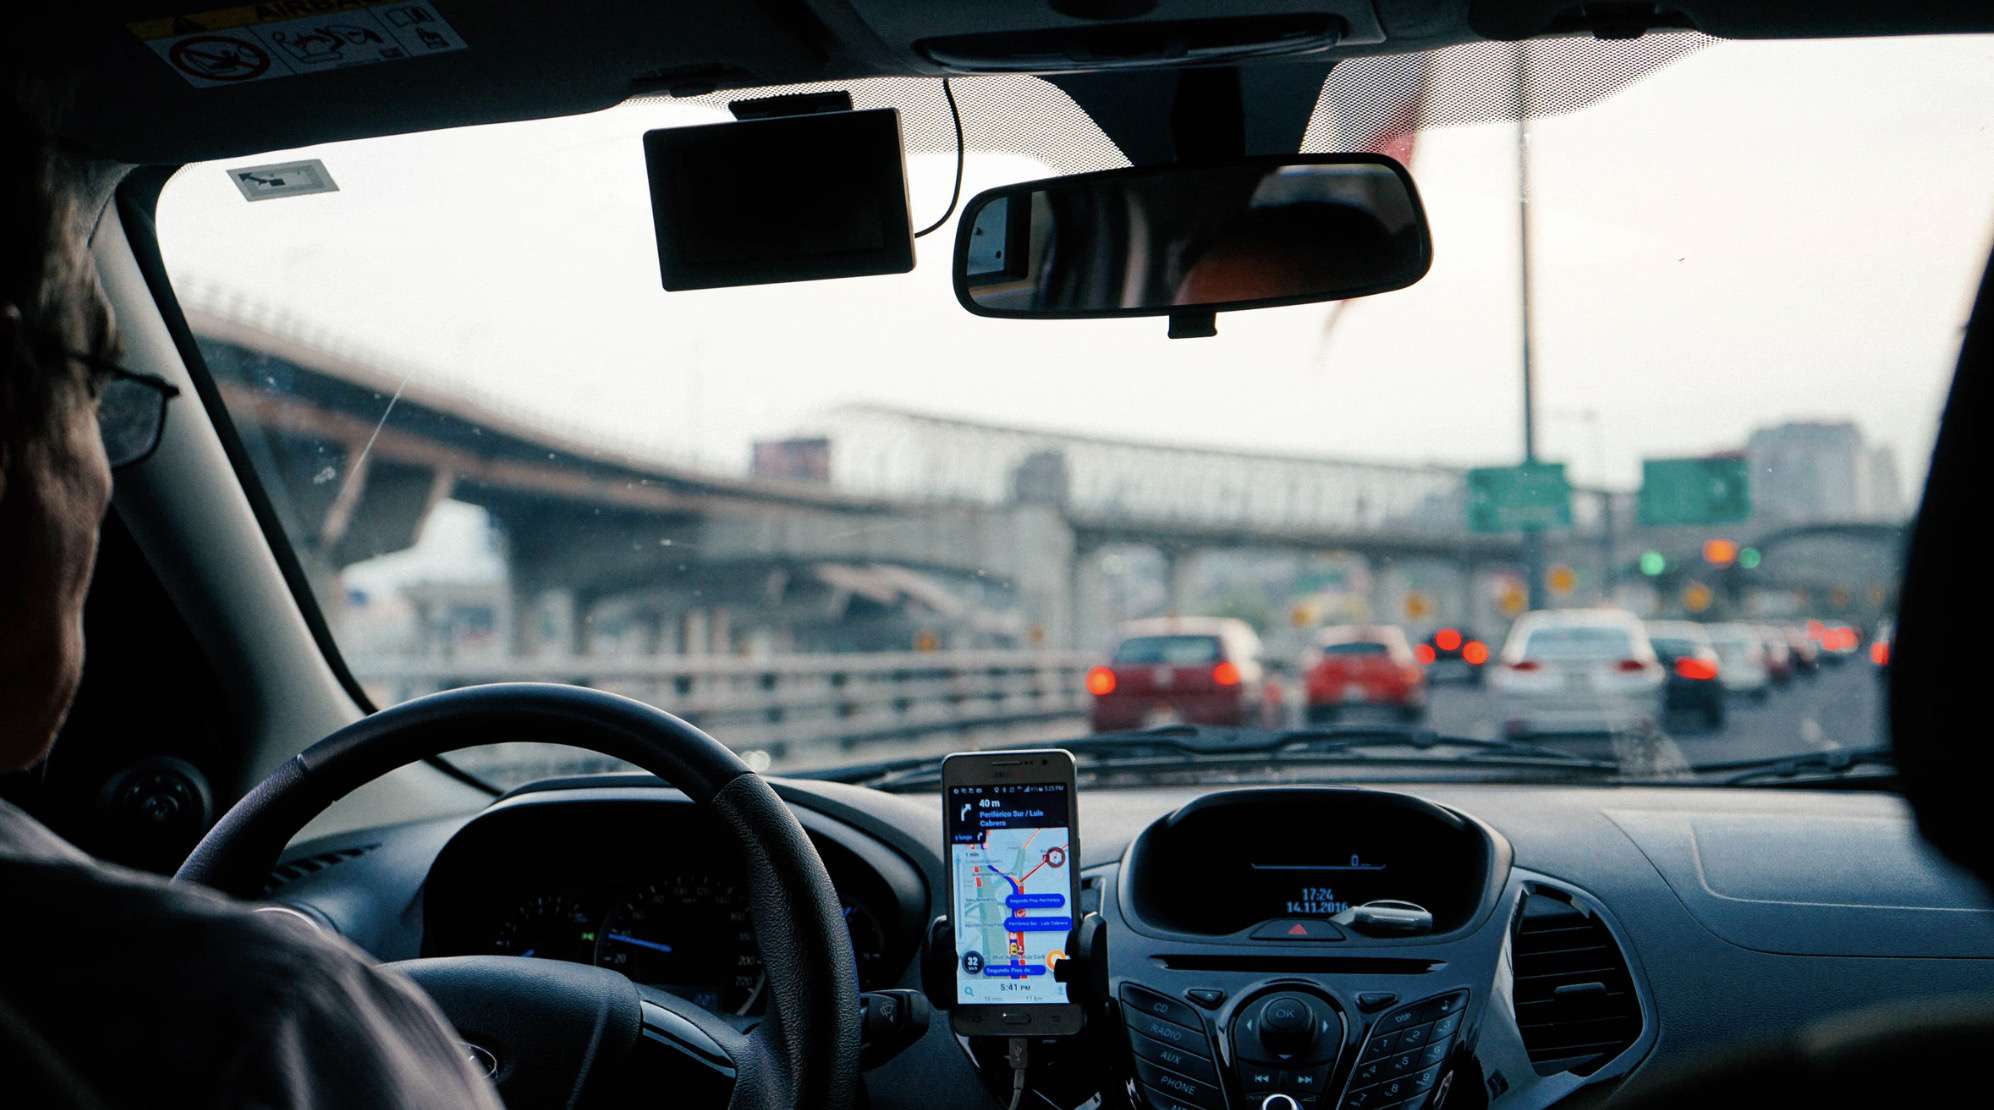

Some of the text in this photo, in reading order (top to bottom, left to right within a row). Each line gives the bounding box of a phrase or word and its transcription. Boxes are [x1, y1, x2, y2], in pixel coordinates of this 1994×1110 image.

[979, 799, 990, 808] 40
[1301, 887, 1334, 900] 17:24
[1286, 901, 1349, 913] 14.11.2016
[967, 957, 978, 966] 32
[1152, 1002, 1169, 1014] CD
[1275, 1007, 1296, 1019] OK
[1150, 1022, 1182, 1041] RADIO
[1160, 1050, 1183, 1065] AUX
[1161, 1075, 1197, 1096] PHONE
